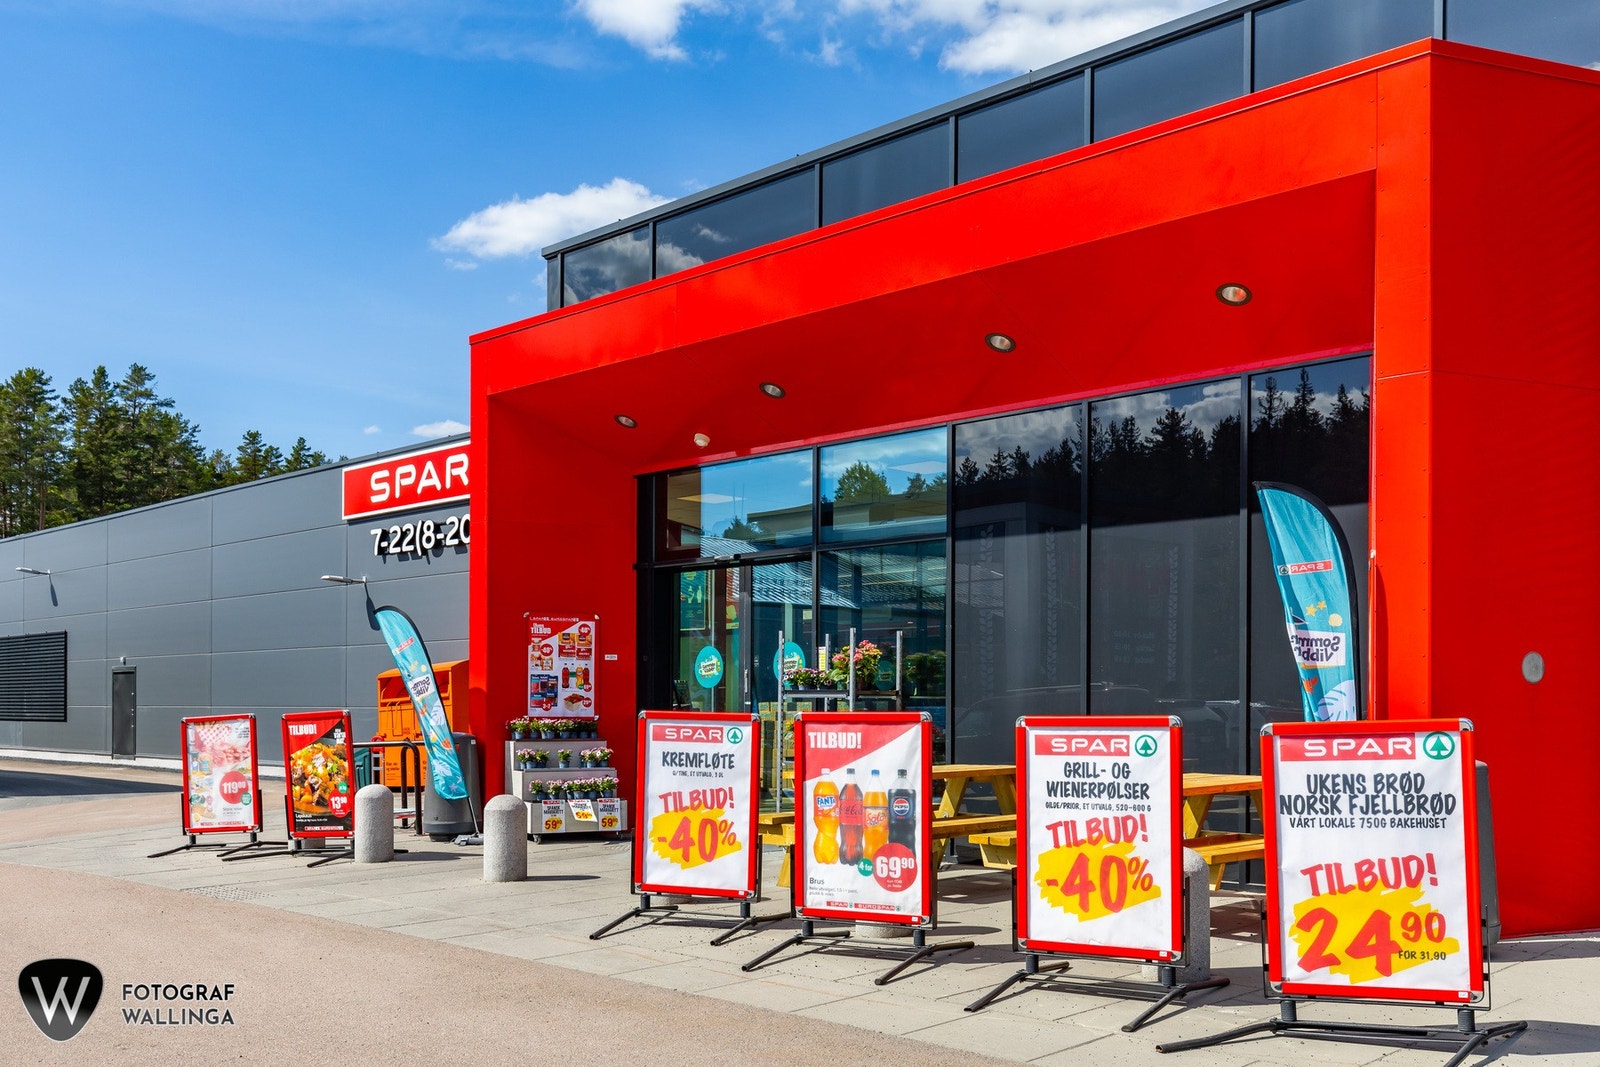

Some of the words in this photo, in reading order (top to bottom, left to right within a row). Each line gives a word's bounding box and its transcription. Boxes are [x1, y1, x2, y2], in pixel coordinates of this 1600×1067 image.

[370, 453, 469, 503] SPAR
[288, 724, 317, 735] TILBUD!
[665, 728, 722, 740] SPAR
[808, 732, 862, 749] TILBUD!
[1051, 738, 1128, 753] SPAR
[1303, 737, 1413, 757] SPAR
[662, 751, 735, 770] KREMFLØTE
[1063, 761, 1106, 779] GRILL-
[1112, 762, 1131, 780] OG
[1046, 780, 1150, 800] WIENERPØLSER
[1306, 773, 1367, 795] UKENS
[1374, 772, 1425, 796] BRØD
[658, 787, 735, 813] TILBUD!
[1280, 794, 1342, 815] NORSK
[1349, 793, 1456, 818] FJELLBRØD
[1045, 814, 1148, 849] TILBUD!
[1289, 815, 1316, 829] VÅRT
[1319, 817, 1355, 829] LOKALE
[1359, 817, 1387, 829] 750G
[1390, 817, 1446, 829] BAKEHUSET
[658, 816, 737, 863] -40%
[859, 861, 864, 870] 4
[1300, 853, 1438, 896] TILBUD!
[1045, 852, 1154, 913] -40%
[1398, 950, 1417, 960] FOR
